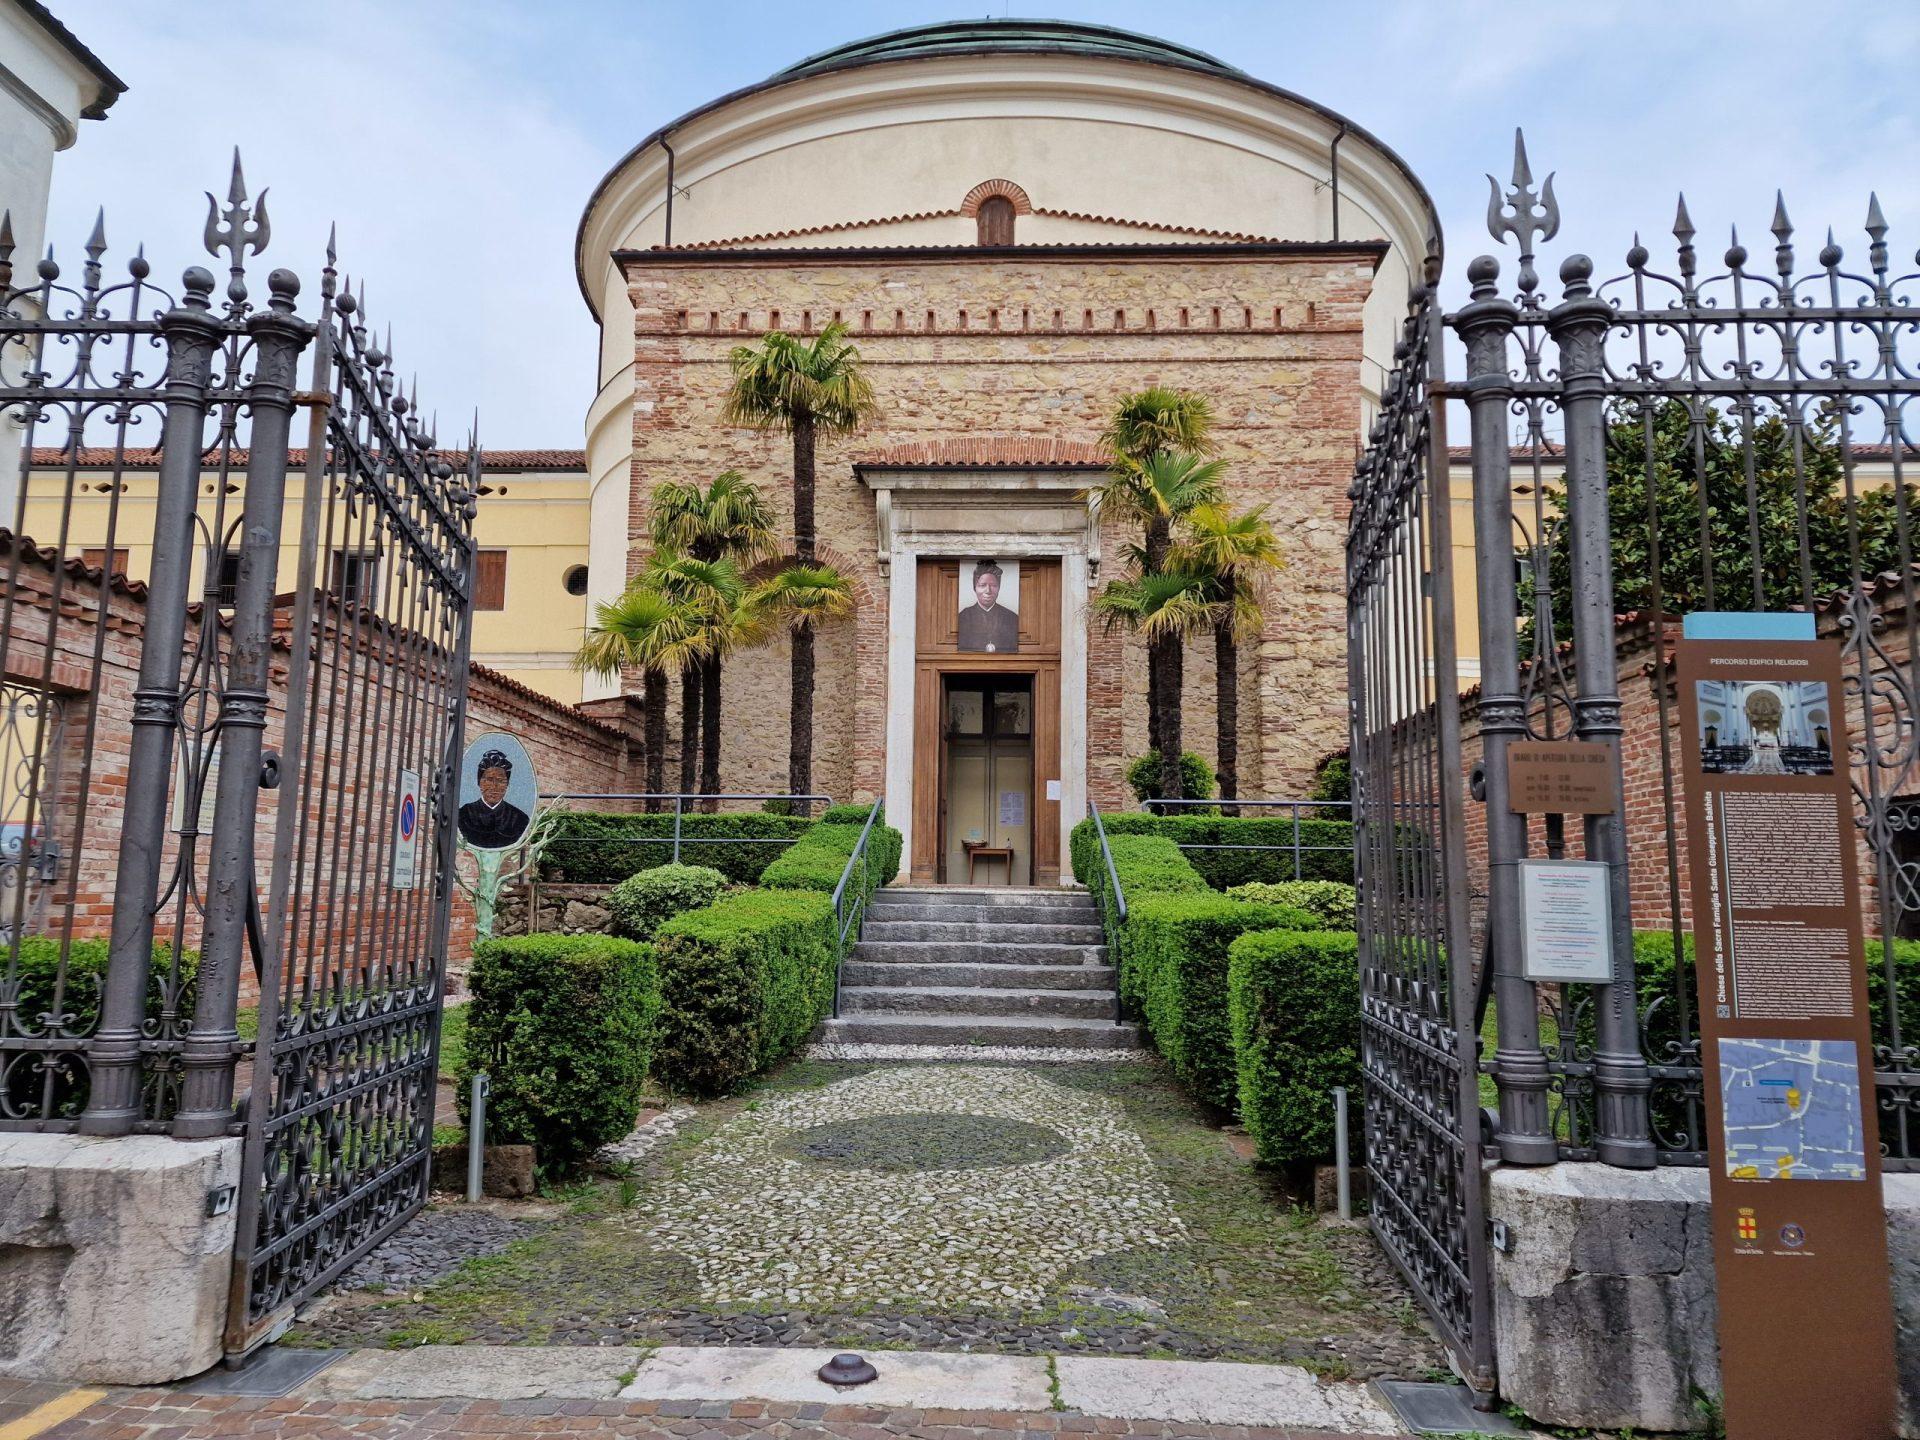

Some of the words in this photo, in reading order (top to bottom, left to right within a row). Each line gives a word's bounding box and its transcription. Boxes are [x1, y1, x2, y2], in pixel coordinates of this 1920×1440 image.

[1710, 658, 1748, 666] PERCORSO
[1749, 658, 1774, 666] EDIFICI
[1775, 658, 1809, 666] RELIGIOSI
[1704, 791, 1714, 821] Bakhita
[1706, 822, 1717, 867] Giuseppina
[1710, 868, 1719, 891] Santa
[1711, 893, 1722, 927] Famiglia
[1714, 928, 1723, 952] Sacra
[1715, 953, 1724, 974] della
[1717, 975, 1726, 1003] Chiesa
